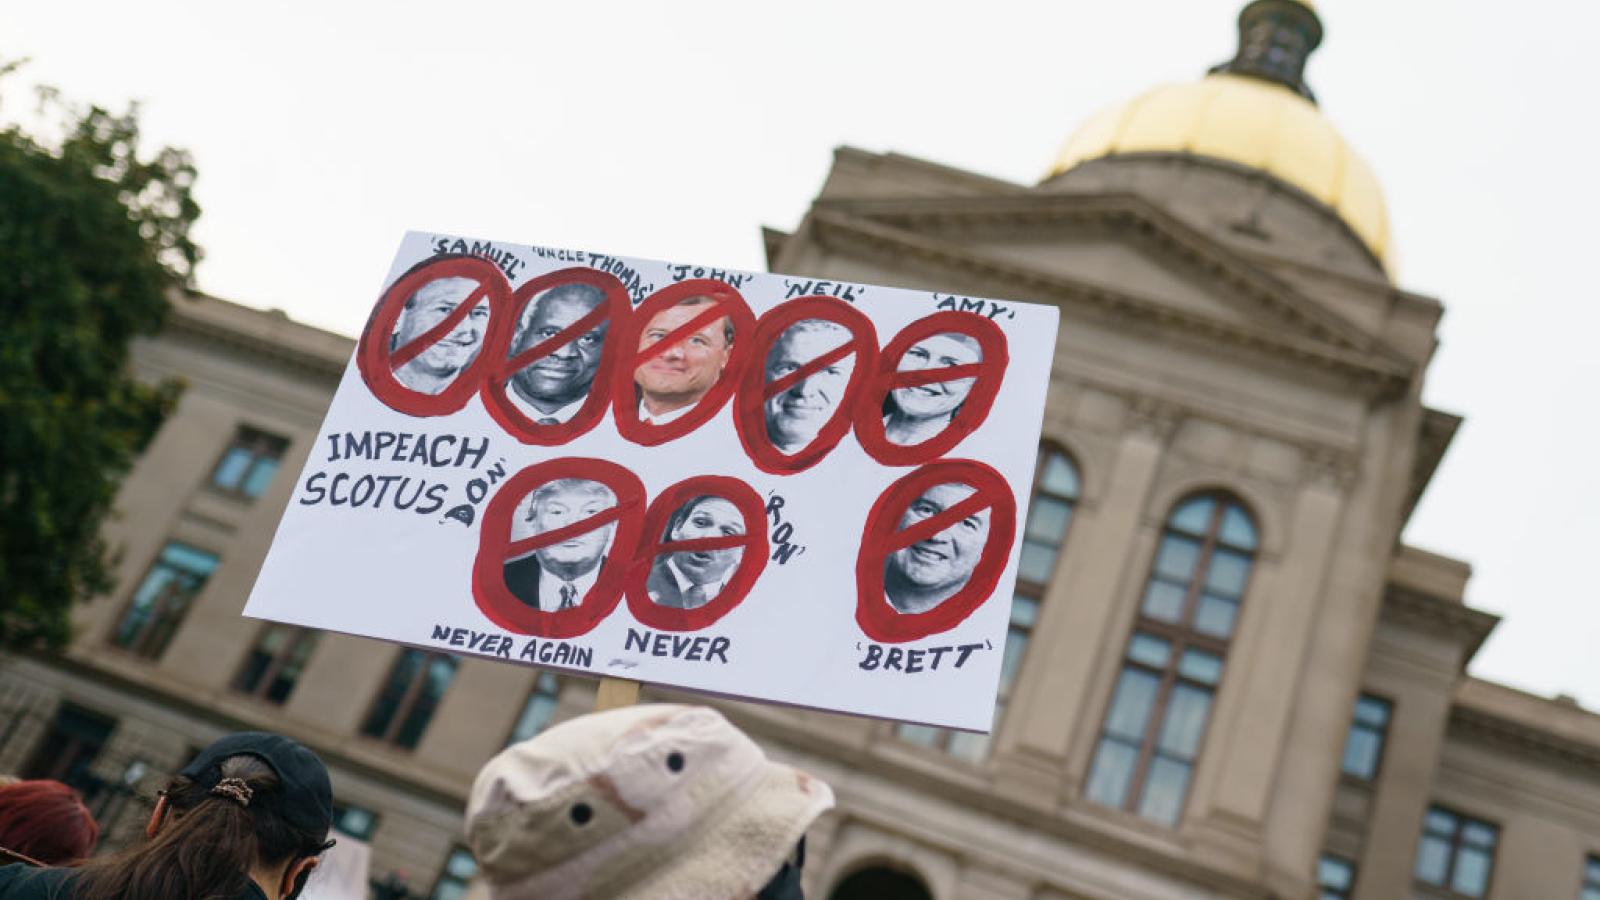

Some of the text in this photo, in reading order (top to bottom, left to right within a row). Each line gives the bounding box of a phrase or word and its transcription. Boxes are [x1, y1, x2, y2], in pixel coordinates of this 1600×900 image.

[430, 236, 525, 280] 'SAMUEL'
[666, 263, 753, 289] 'JOHN'
[785, 279, 865, 302] 'NEIL'
[933, 292, 1015, 320] 'AMY'
[327, 431, 490, 469] IMPEACH
[300, 471, 448, 514] SCOTUS
[431, 625, 593, 668] NEVER AGAIN
[624, 627, 731, 664] NEVER
[856, 639, 993, 673] 'BRETT'
